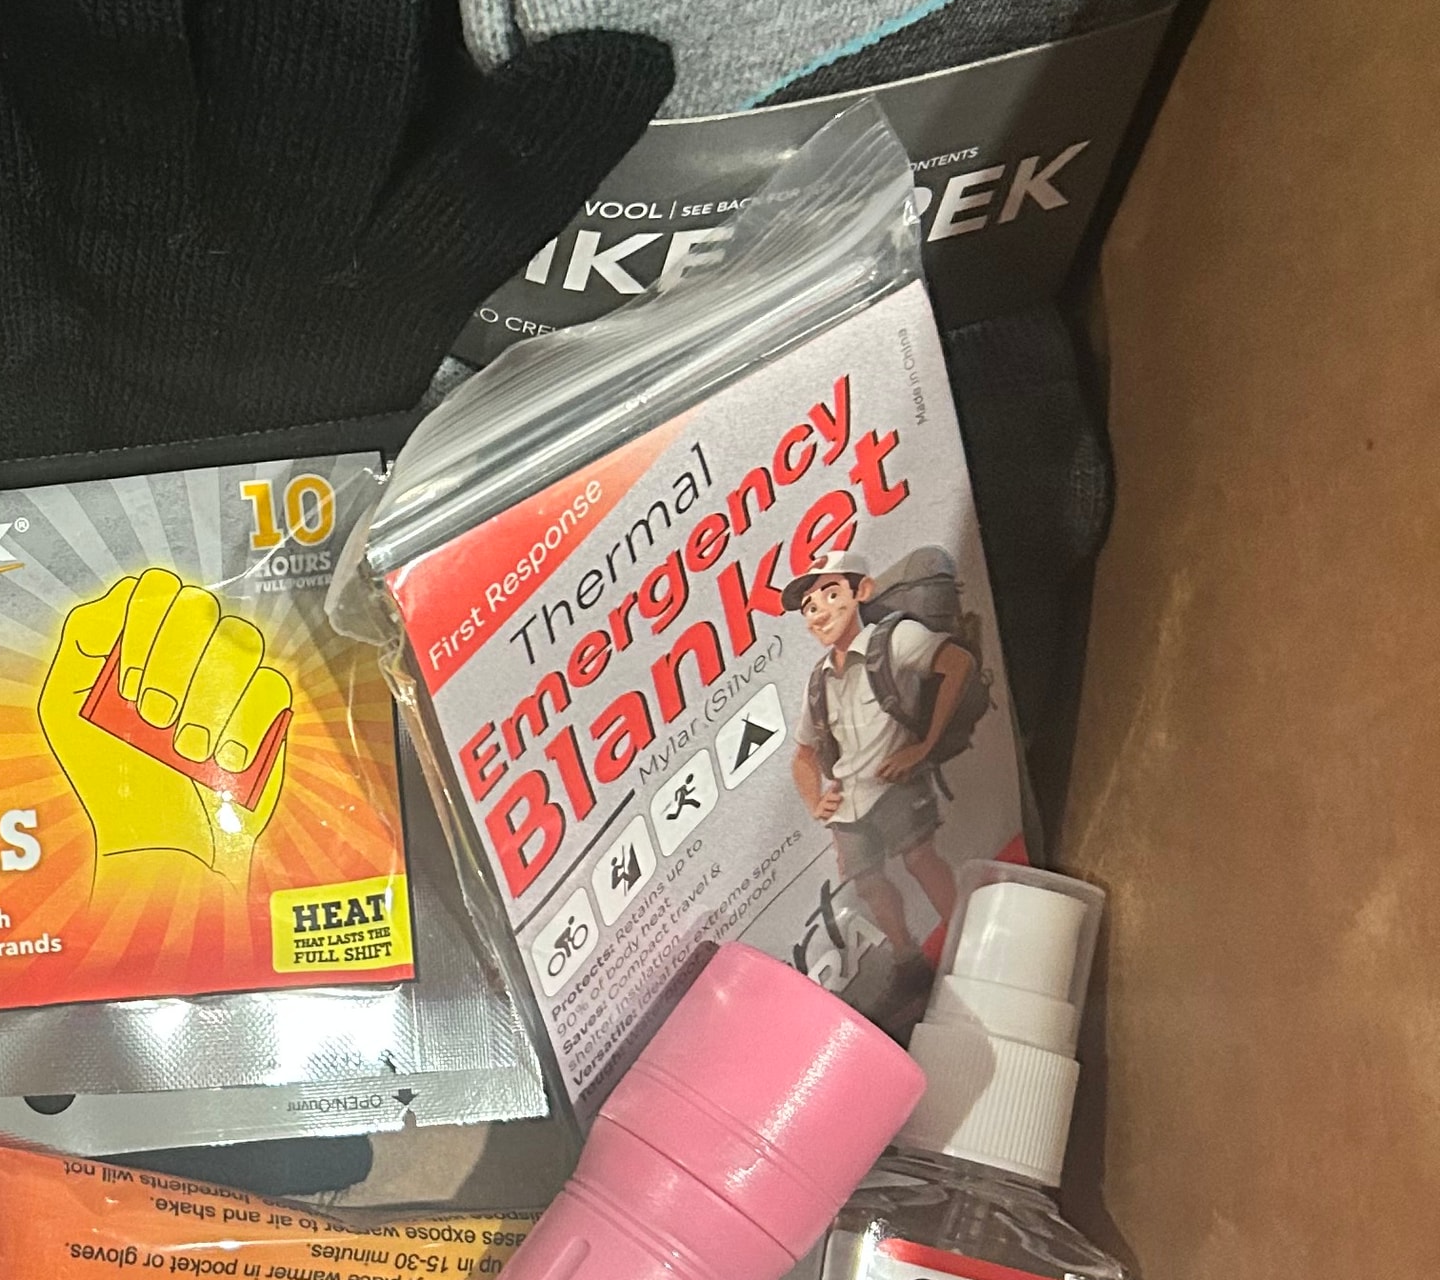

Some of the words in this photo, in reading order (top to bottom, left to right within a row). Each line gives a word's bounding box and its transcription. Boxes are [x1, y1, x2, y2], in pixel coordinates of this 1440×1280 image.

[680, 202, 714, 218] SEE
[523, 229, 737, 295] IKE
[240, 473, 336, 551] 10
[508, 442, 714, 666] Thermal
[428, 607, 486, 671] First
[483, 477, 604, 613] Response
[457, 373, 852, 803] Emergency
[484, 428, 911, 900] Blanket
[691, 877, 753, 945] extreme
[751, 828, 804, 882] sports
[292, 893, 387, 934] HEAT
[293, 936, 326, 949] THAT
[327, 930, 365, 946] LASTS
[367, 926, 391, 940] THE
[551, 944, 617, 1022] Protects:
[615, 881, 665, 943] Retains
[666, 859, 687, 884] up
[686, 838, 704, 861] to
[293, 949, 340, 964] FULL
[344, 941, 393, 962] SHIFT
[606, 931, 641, 981] body
[562, 1002, 609, 1056] Saves:
[607, 919, 670, 1002] Compact
[670, 878, 710, 928] travel
[63, 1160, 96, 1176] not
[101, 1165, 135, 1183] will
[149, 1196, 217, 1219] shake.
[223, 1206, 261, 1223] and
[265, 1213, 294, 1231] air
[299, 1216, 320, 1234] to
[404, 1226, 477, 1246] expose
[64, 1241, 139, 1267] gloves.
[142, 1253, 165, 1267] or
[306, 1242, 390, 1265] minutes.
[394, 1252, 449, 1274] 15-30
[169, 1255, 239, 1278] pocket
[243, 1263, 262, 1279] in
[456, 1259, 475, 1277] in
[479, 1260, 502, 1275] up
